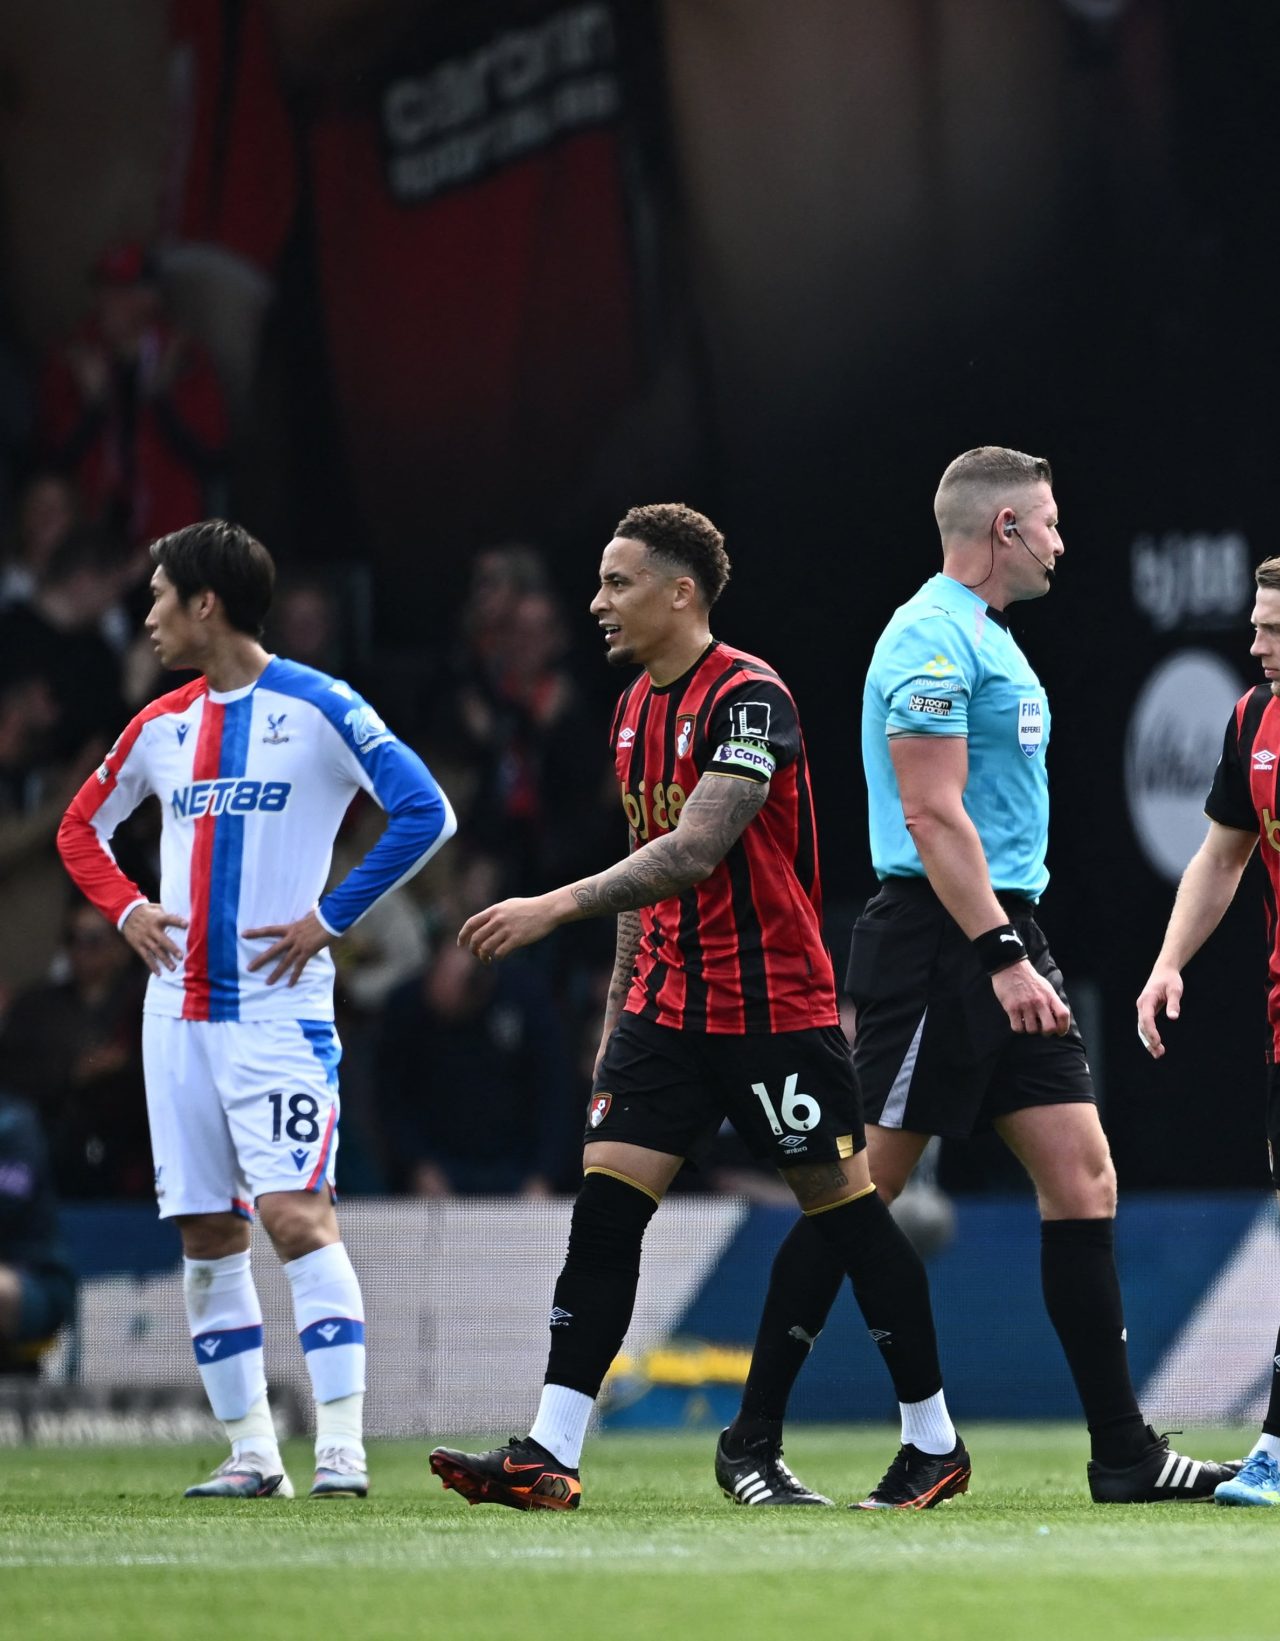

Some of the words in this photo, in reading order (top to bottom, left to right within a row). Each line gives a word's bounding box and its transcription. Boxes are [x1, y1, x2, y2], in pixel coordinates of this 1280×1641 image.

[908, 702, 923, 712] for
[911, 694, 924, 705] No
[924, 699, 949, 709] room
[1022, 702, 1041, 717] FIFA
[734, 748, 776, 773] Capta
[172, 781, 292, 819] NET88
[621, 780, 686, 840] bj88
[268, 1093, 320, 1143] 18
[751, 1072, 821, 1135] 16
